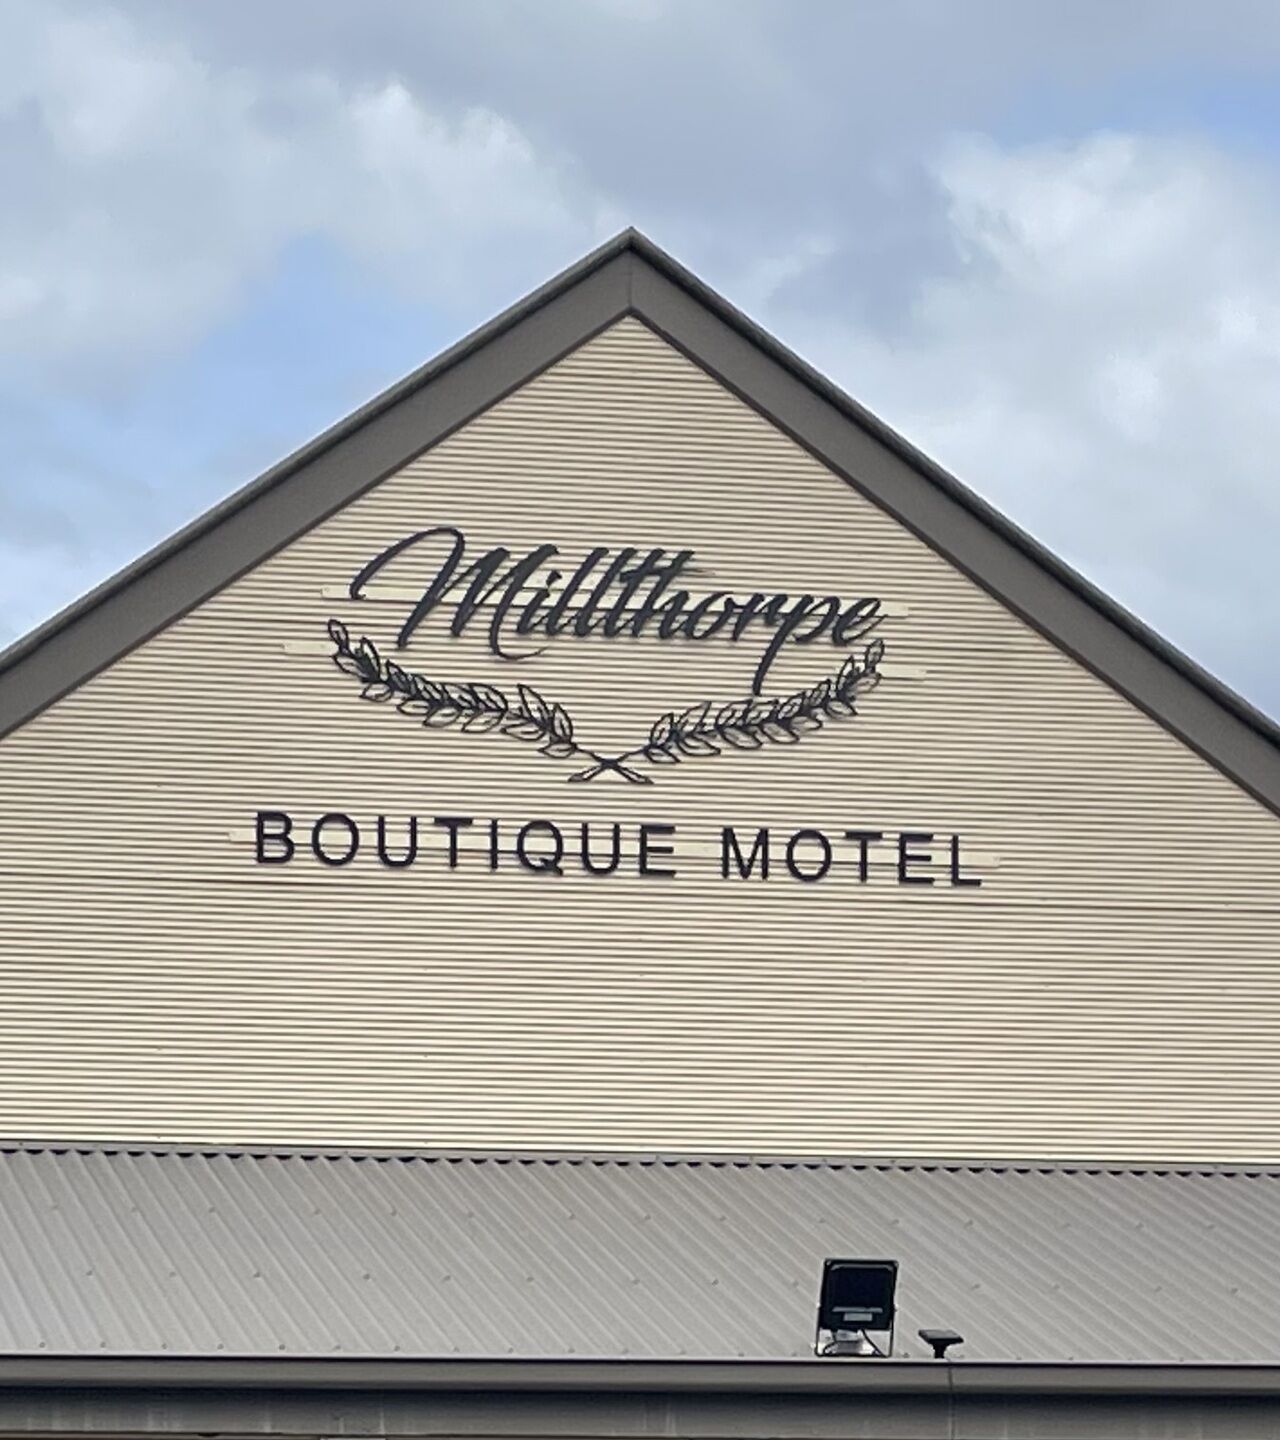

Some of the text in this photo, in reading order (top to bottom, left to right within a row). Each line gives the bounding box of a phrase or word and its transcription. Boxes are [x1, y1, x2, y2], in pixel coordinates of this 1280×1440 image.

[350, 527, 887, 697] Millthorpe
[256, 811, 981, 887] BOUTIQUE MOTEL
